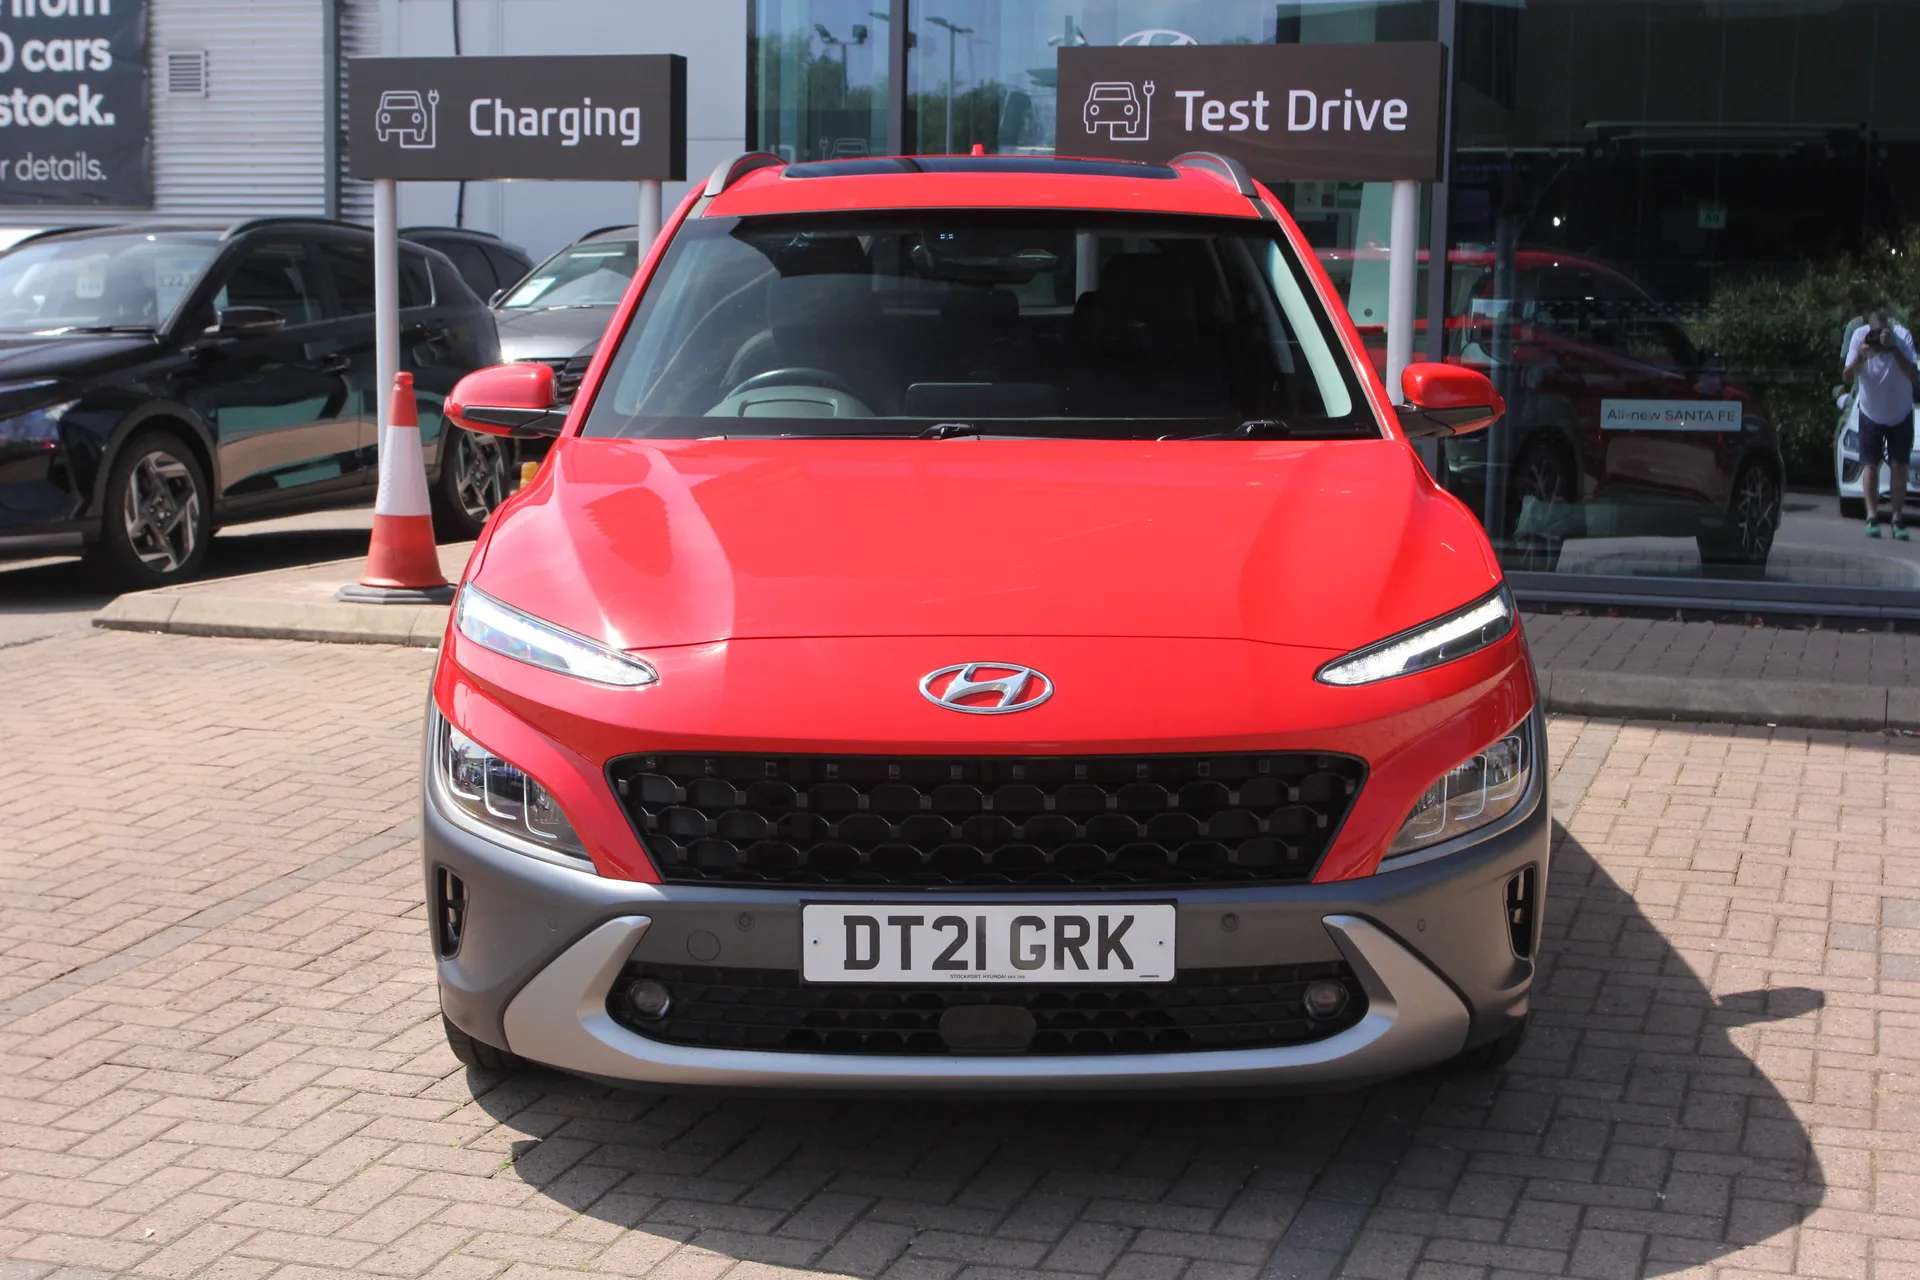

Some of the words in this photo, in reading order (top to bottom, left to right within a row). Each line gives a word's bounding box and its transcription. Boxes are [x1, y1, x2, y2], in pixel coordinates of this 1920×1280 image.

[21, 38, 113, 73] cars
[0, 84, 116, 127] stock.
[470, 97, 641, 147] Charging
[1175, 90, 1270, 132] Test
[1288, 88, 1408, 132] Drive
[15, 152, 107, 182] details.
[1607, 408, 1661, 421] All-new
[1664, 409, 1714, 422] SANTA
[1718, 410, 1737, 422] FE
[843, 914, 987, 971] DT21
[1009, 914, 1135, 971] GRK
